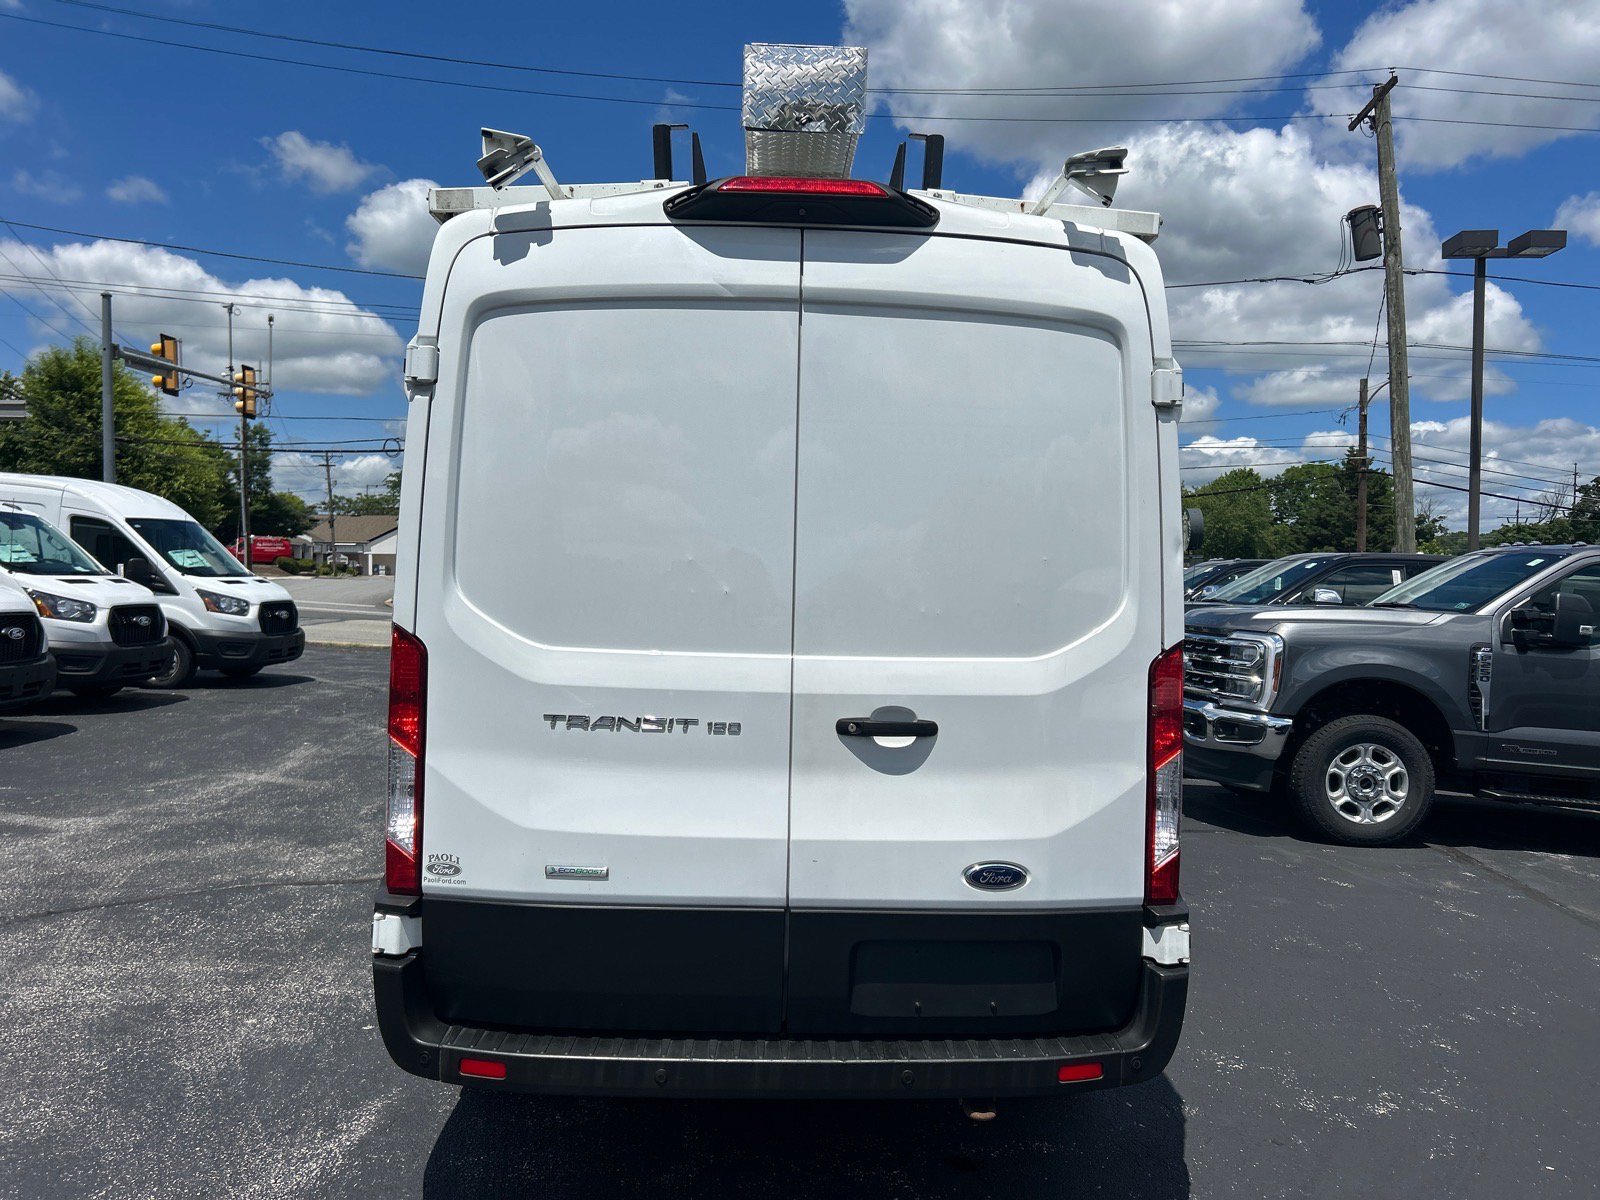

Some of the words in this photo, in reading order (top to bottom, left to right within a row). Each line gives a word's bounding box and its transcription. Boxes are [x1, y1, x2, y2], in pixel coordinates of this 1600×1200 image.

[543, 713, 699, 735] TRANSIT
[428, 853, 460, 865] PAOLI
[432, 863, 455, 875] Ford
[423, 876, 467, 885] PaoliFord.com
[979, 868, 1014, 884] Ford
